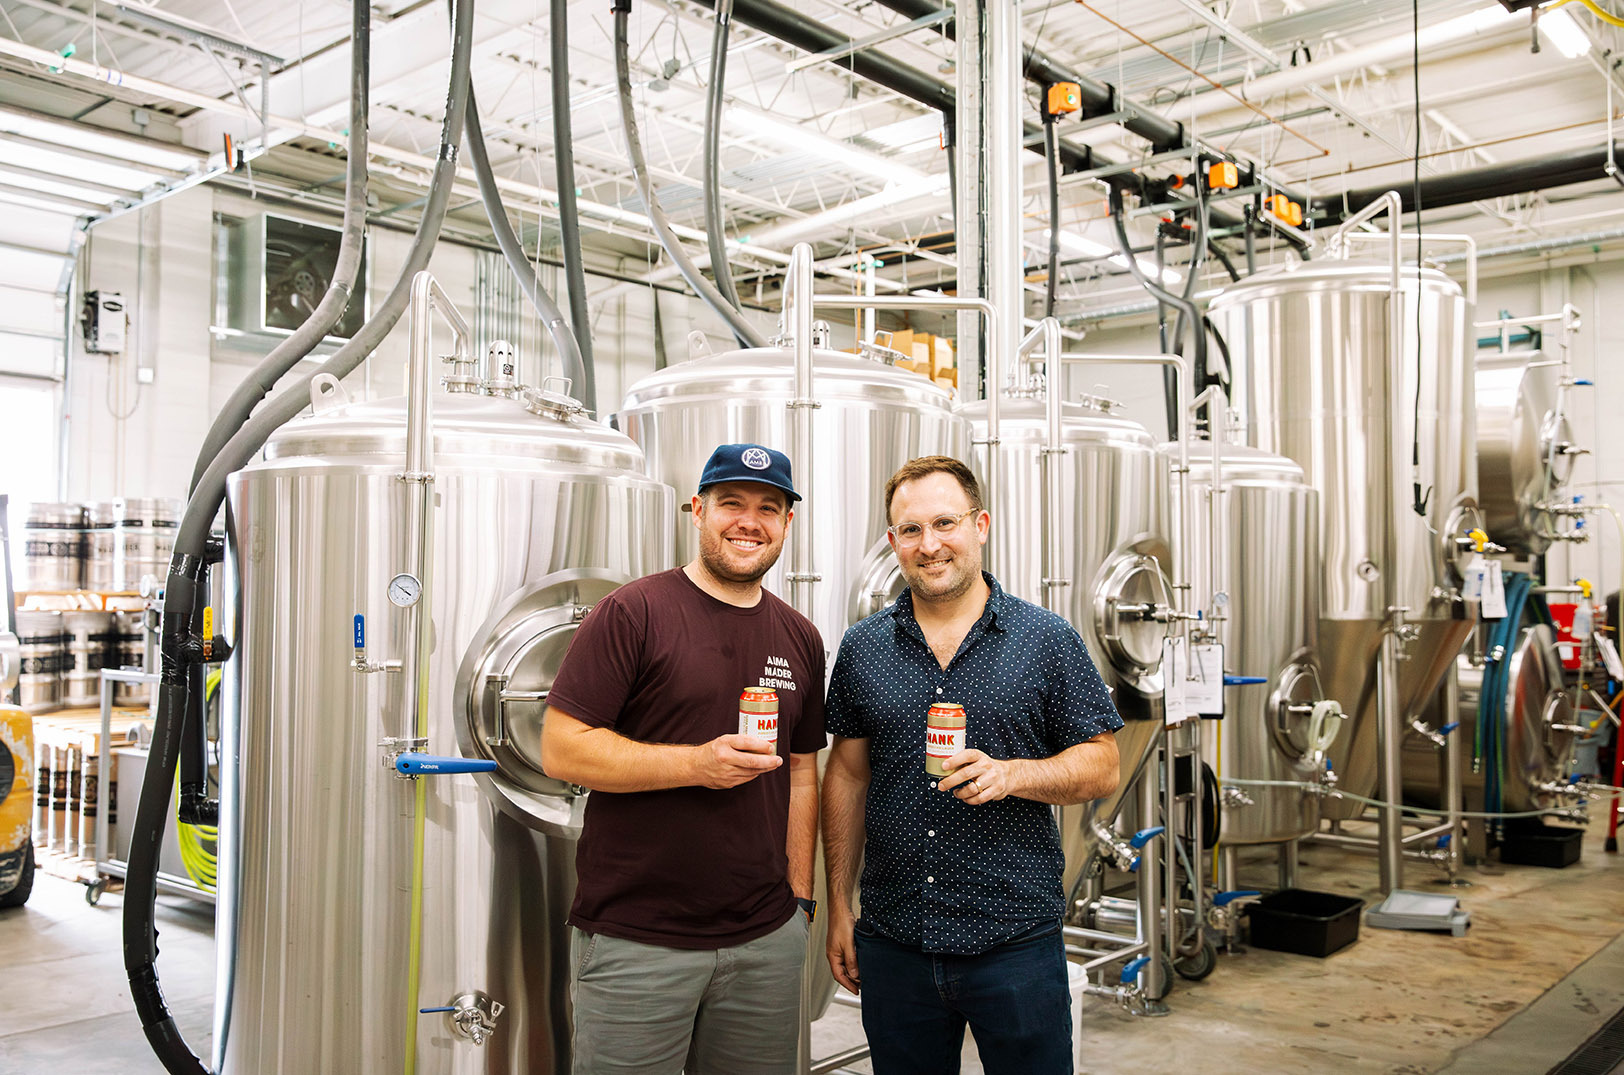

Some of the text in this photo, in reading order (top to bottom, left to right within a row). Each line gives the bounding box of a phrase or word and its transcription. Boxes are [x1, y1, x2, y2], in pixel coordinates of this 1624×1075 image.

[764, 666, 792, 679] MADER
[759, 677, 796, 691] BREWING
[927, 732, 955, 746] HANK
